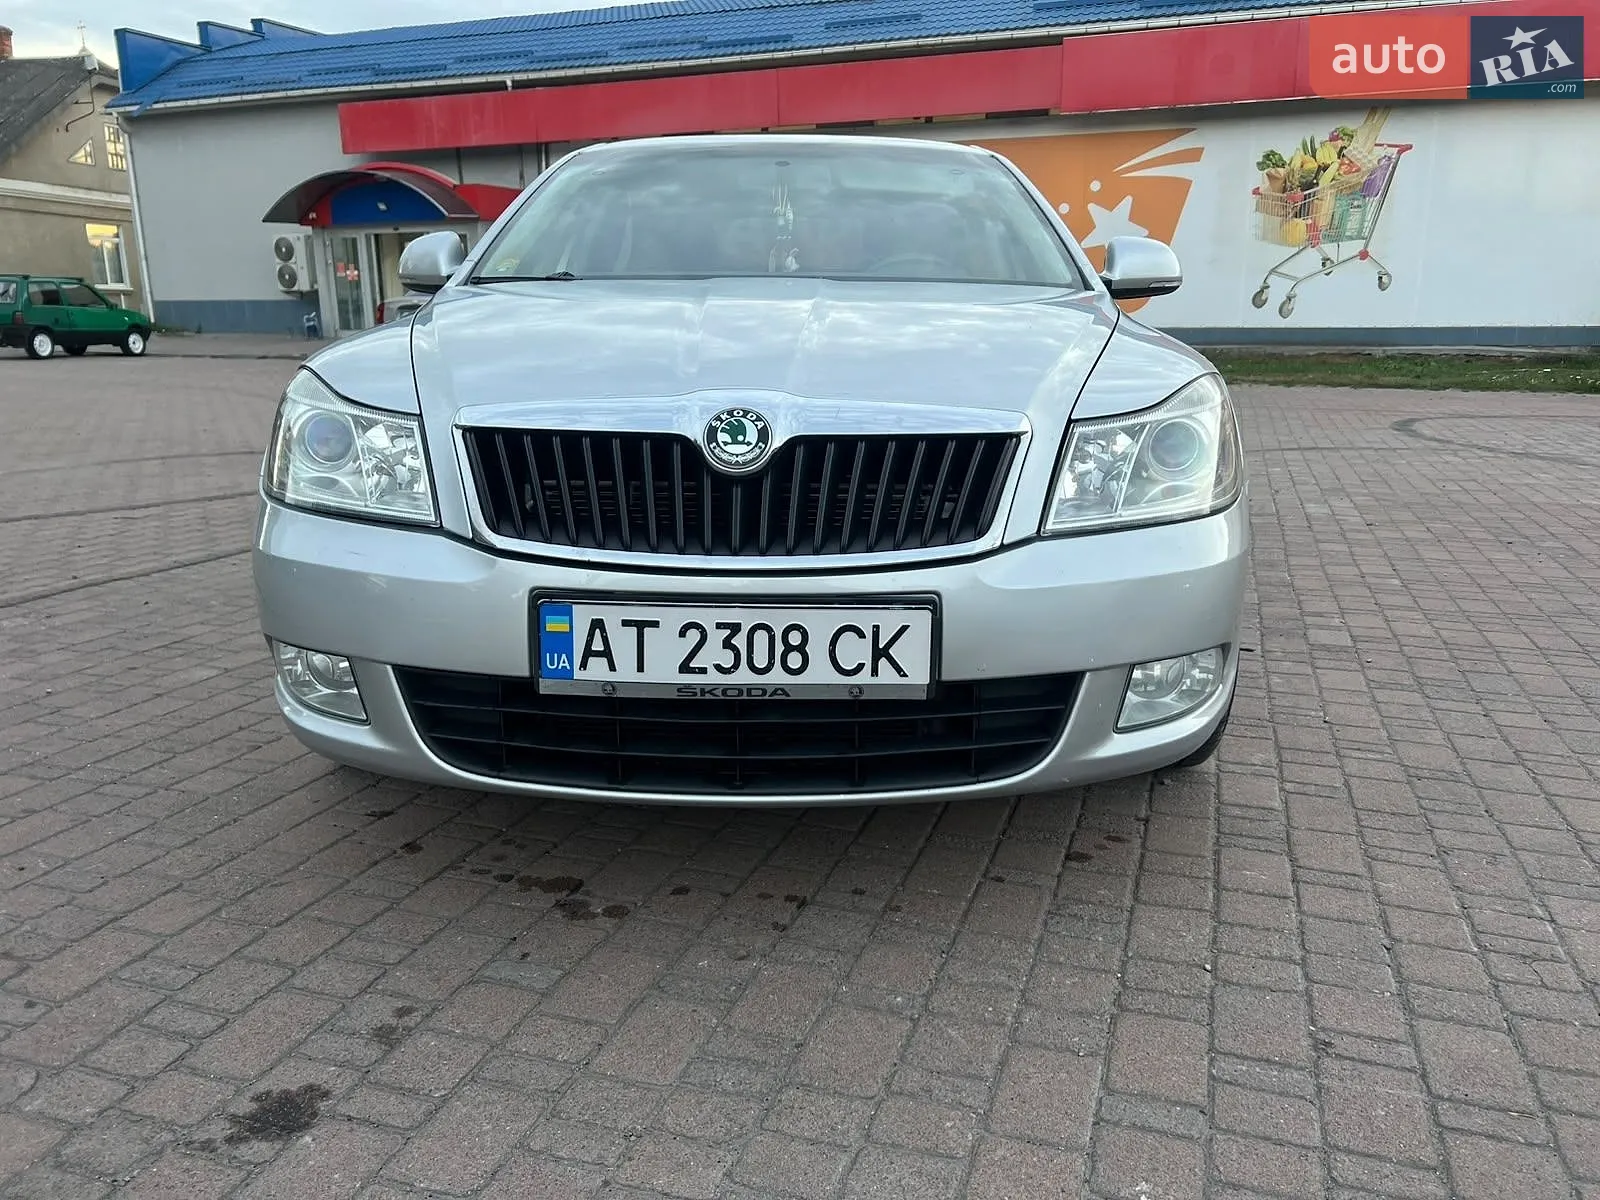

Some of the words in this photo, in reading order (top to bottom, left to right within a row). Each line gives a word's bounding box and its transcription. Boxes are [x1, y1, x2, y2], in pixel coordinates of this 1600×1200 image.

[546, 652, 571, 670] UA
[578, 617, 661, 673] AT
[678, 620, 810, 676] 2308
[828, 623, 912, 678] CK
